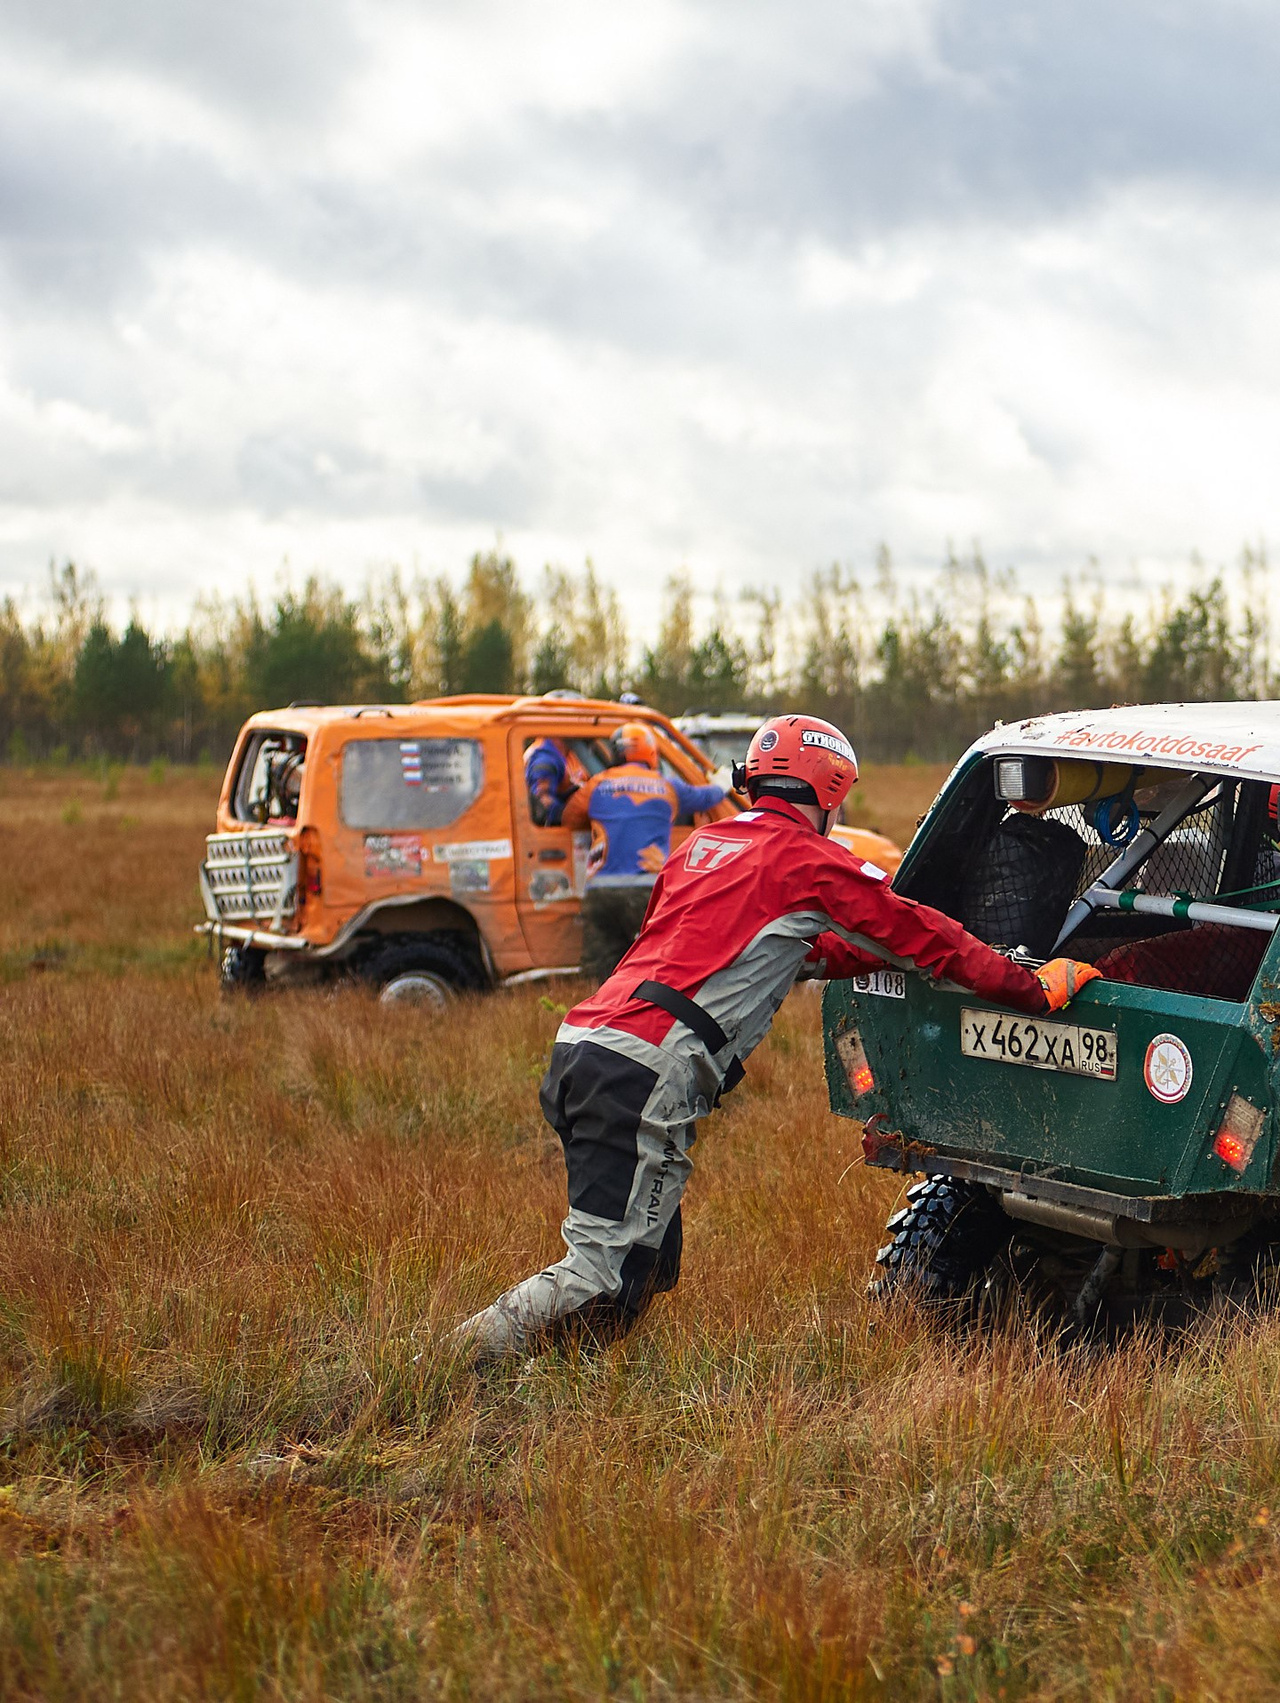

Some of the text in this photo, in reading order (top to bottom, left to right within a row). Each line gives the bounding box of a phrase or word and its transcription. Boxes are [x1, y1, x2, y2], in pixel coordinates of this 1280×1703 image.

[1052, 728, 1264, 762] #avtokotdosaaf
[687, 837, 747, 869] FT
[1082, 1032, 1108, 1063] 98
[1081, 1060, 1101, 1073] RUS
